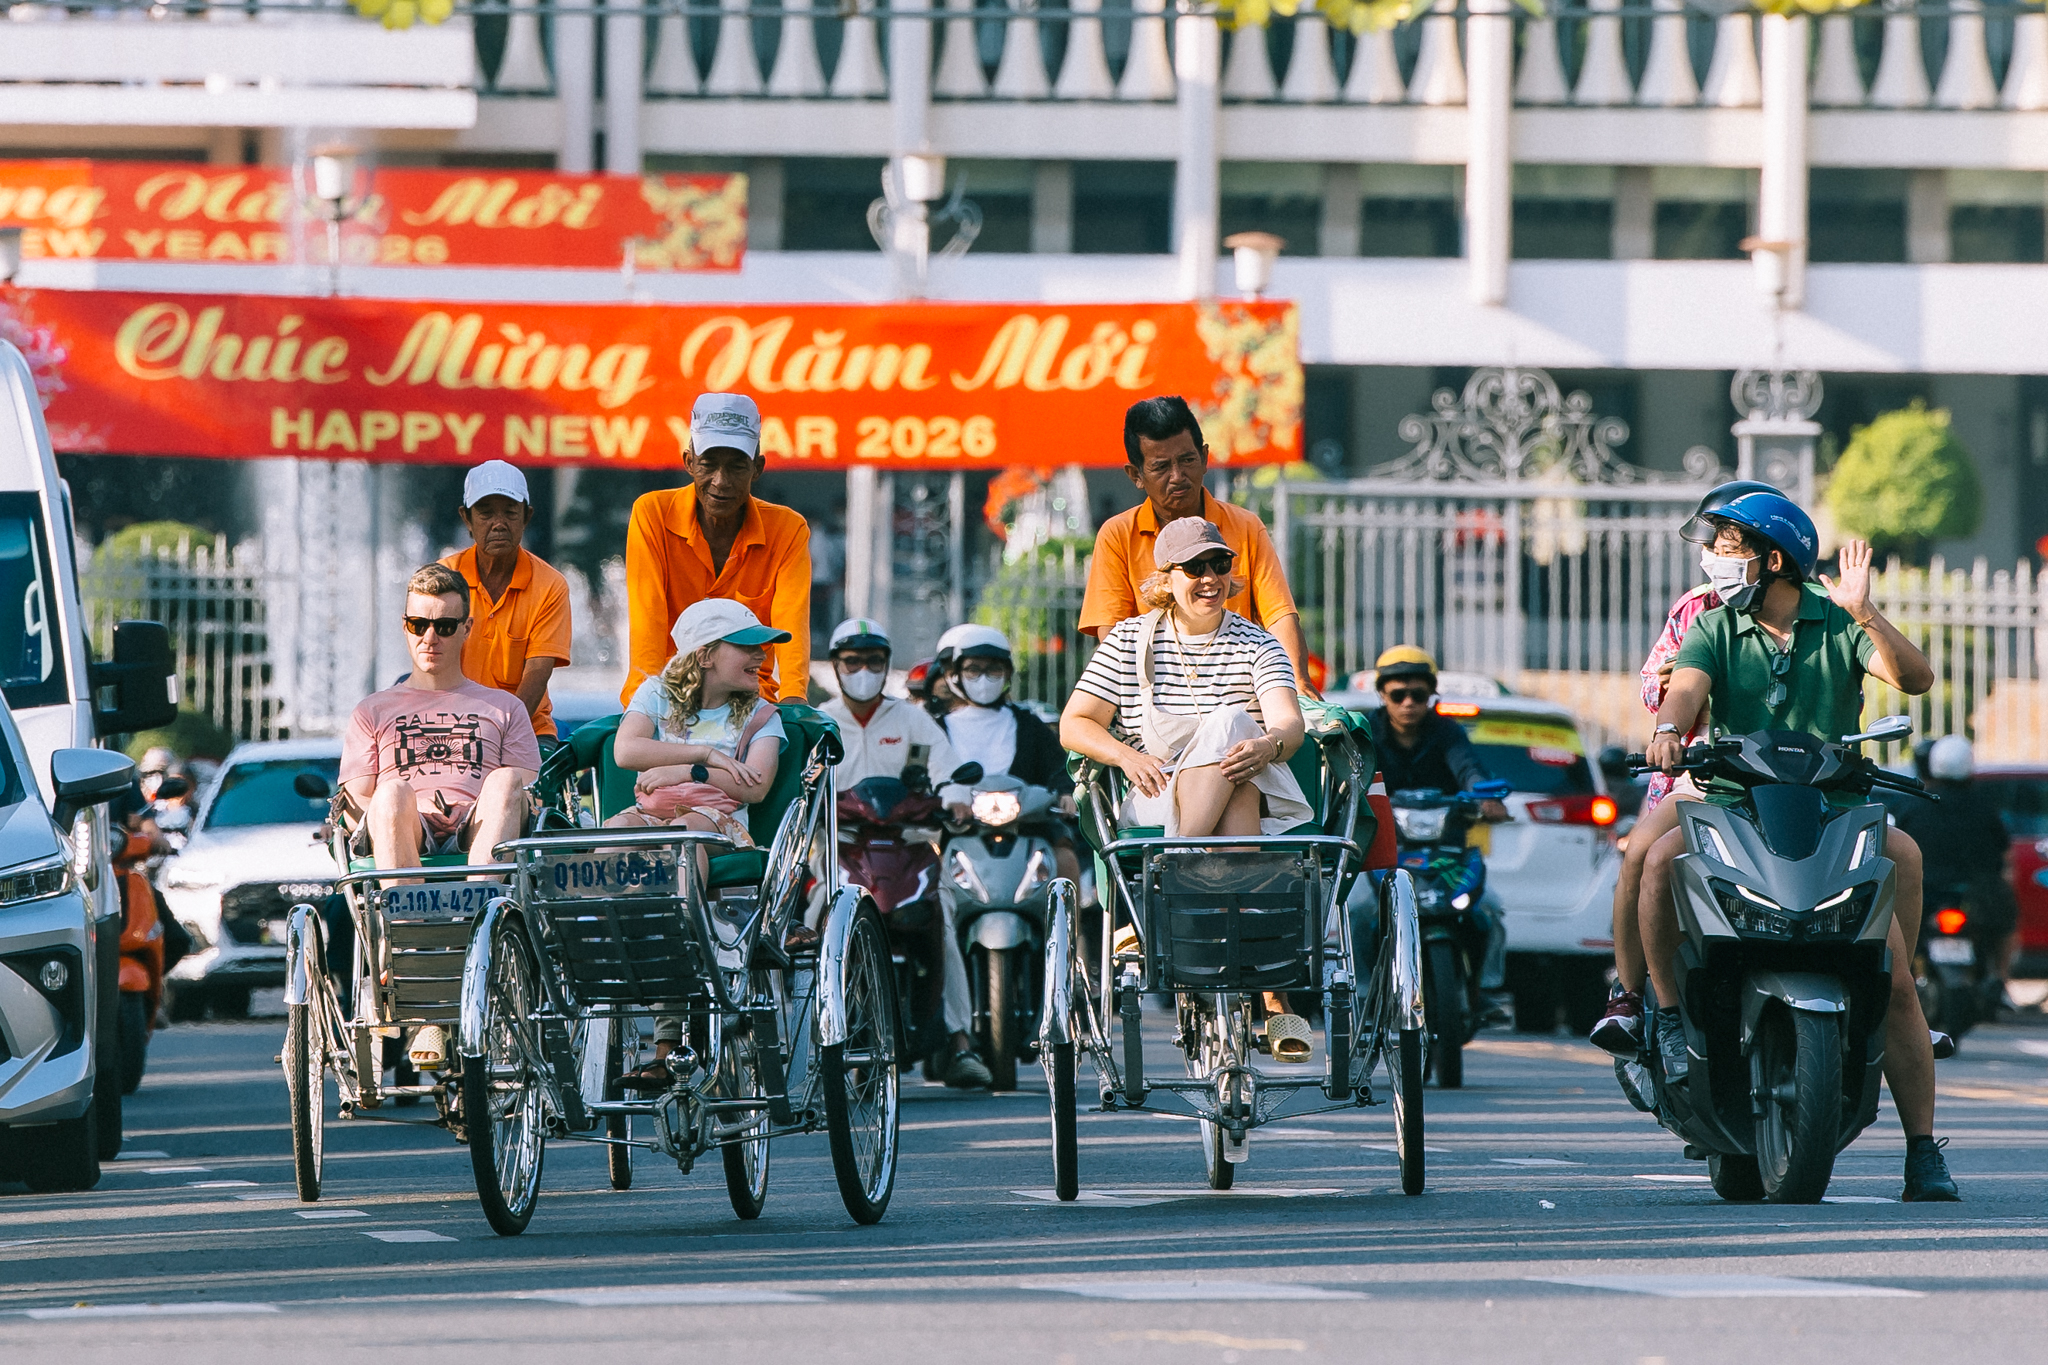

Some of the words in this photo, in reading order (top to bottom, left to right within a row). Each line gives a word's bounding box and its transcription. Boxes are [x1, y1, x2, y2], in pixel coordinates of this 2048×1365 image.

[402, 176, 602, 229] Mới
[21, 227, 107, 257] EW
[122, 228, 290, 260] YEAR
[115, 302, 349, 383] Chúc
[363, 311, 655, 409] Mừng
[680, 315, 939, 393] Năm
[950, 313, 1156, 392] Mới
[271, 406, 485, 455] HAPPY
[503, 414, 649, 459] NEW
[665, 416, 838, 459] YAR
[856, 414, 997, 458] 2026
[395, 713, 479, 727] SALTYS
[1778, 746, 1806, 754] HONDA
[554, 860, 607, 891] Q10X
